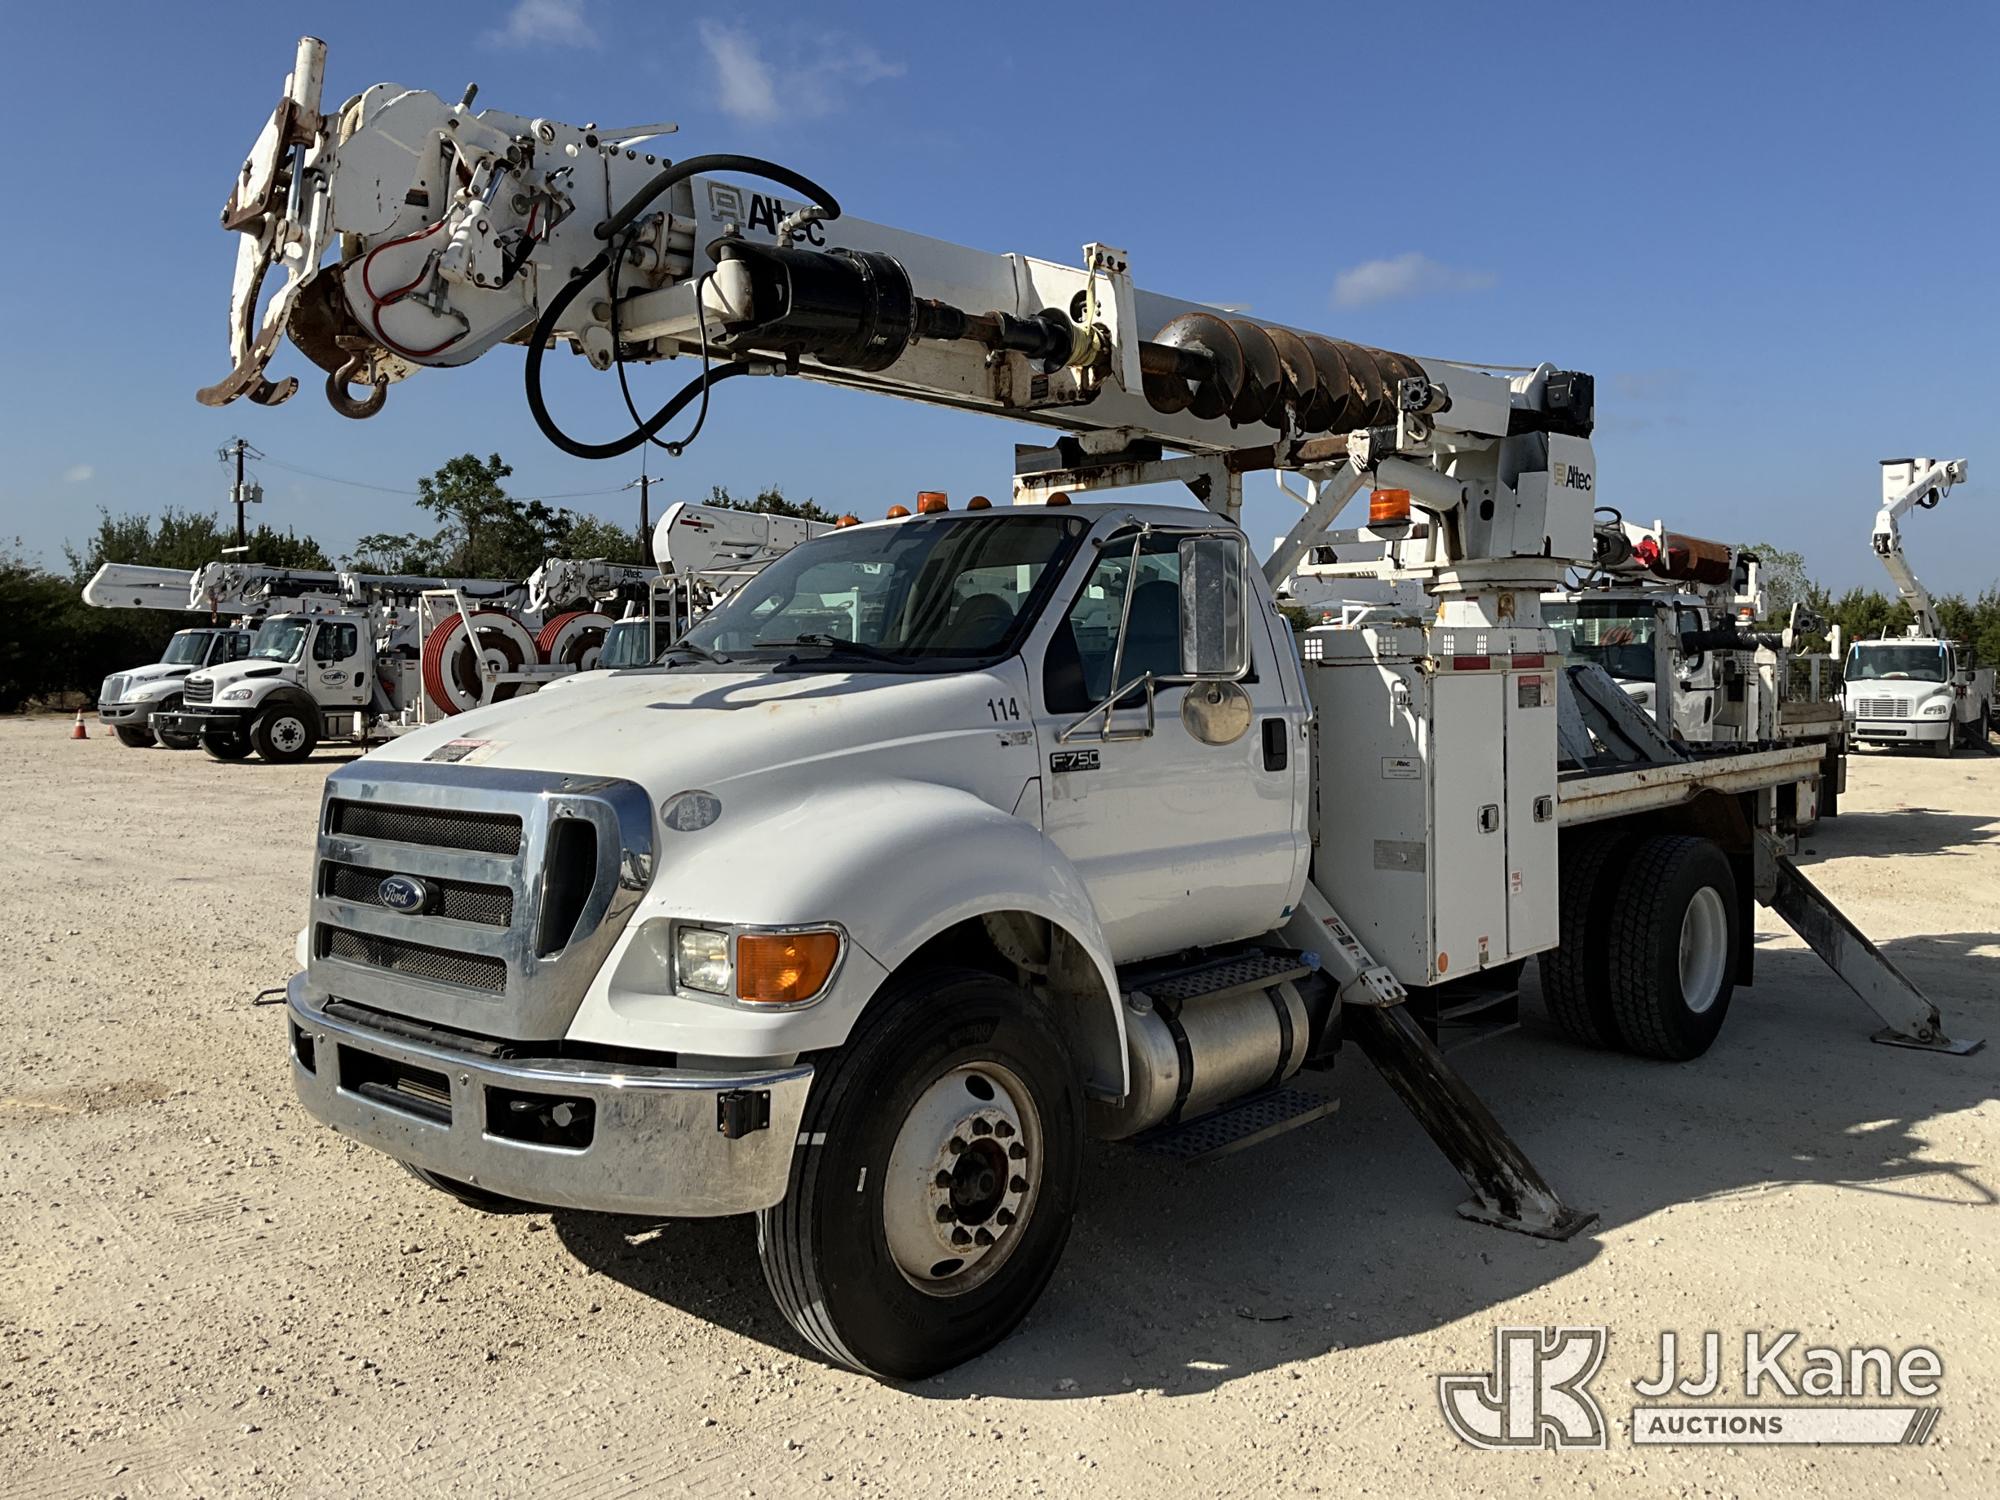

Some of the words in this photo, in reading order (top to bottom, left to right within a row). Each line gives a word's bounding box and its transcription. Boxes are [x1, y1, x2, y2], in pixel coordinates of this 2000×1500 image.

[1566, 465, 1592, 491] Altec
[988, 697, 1020, 722] 114
[384, 882, 409, 904] Ford
